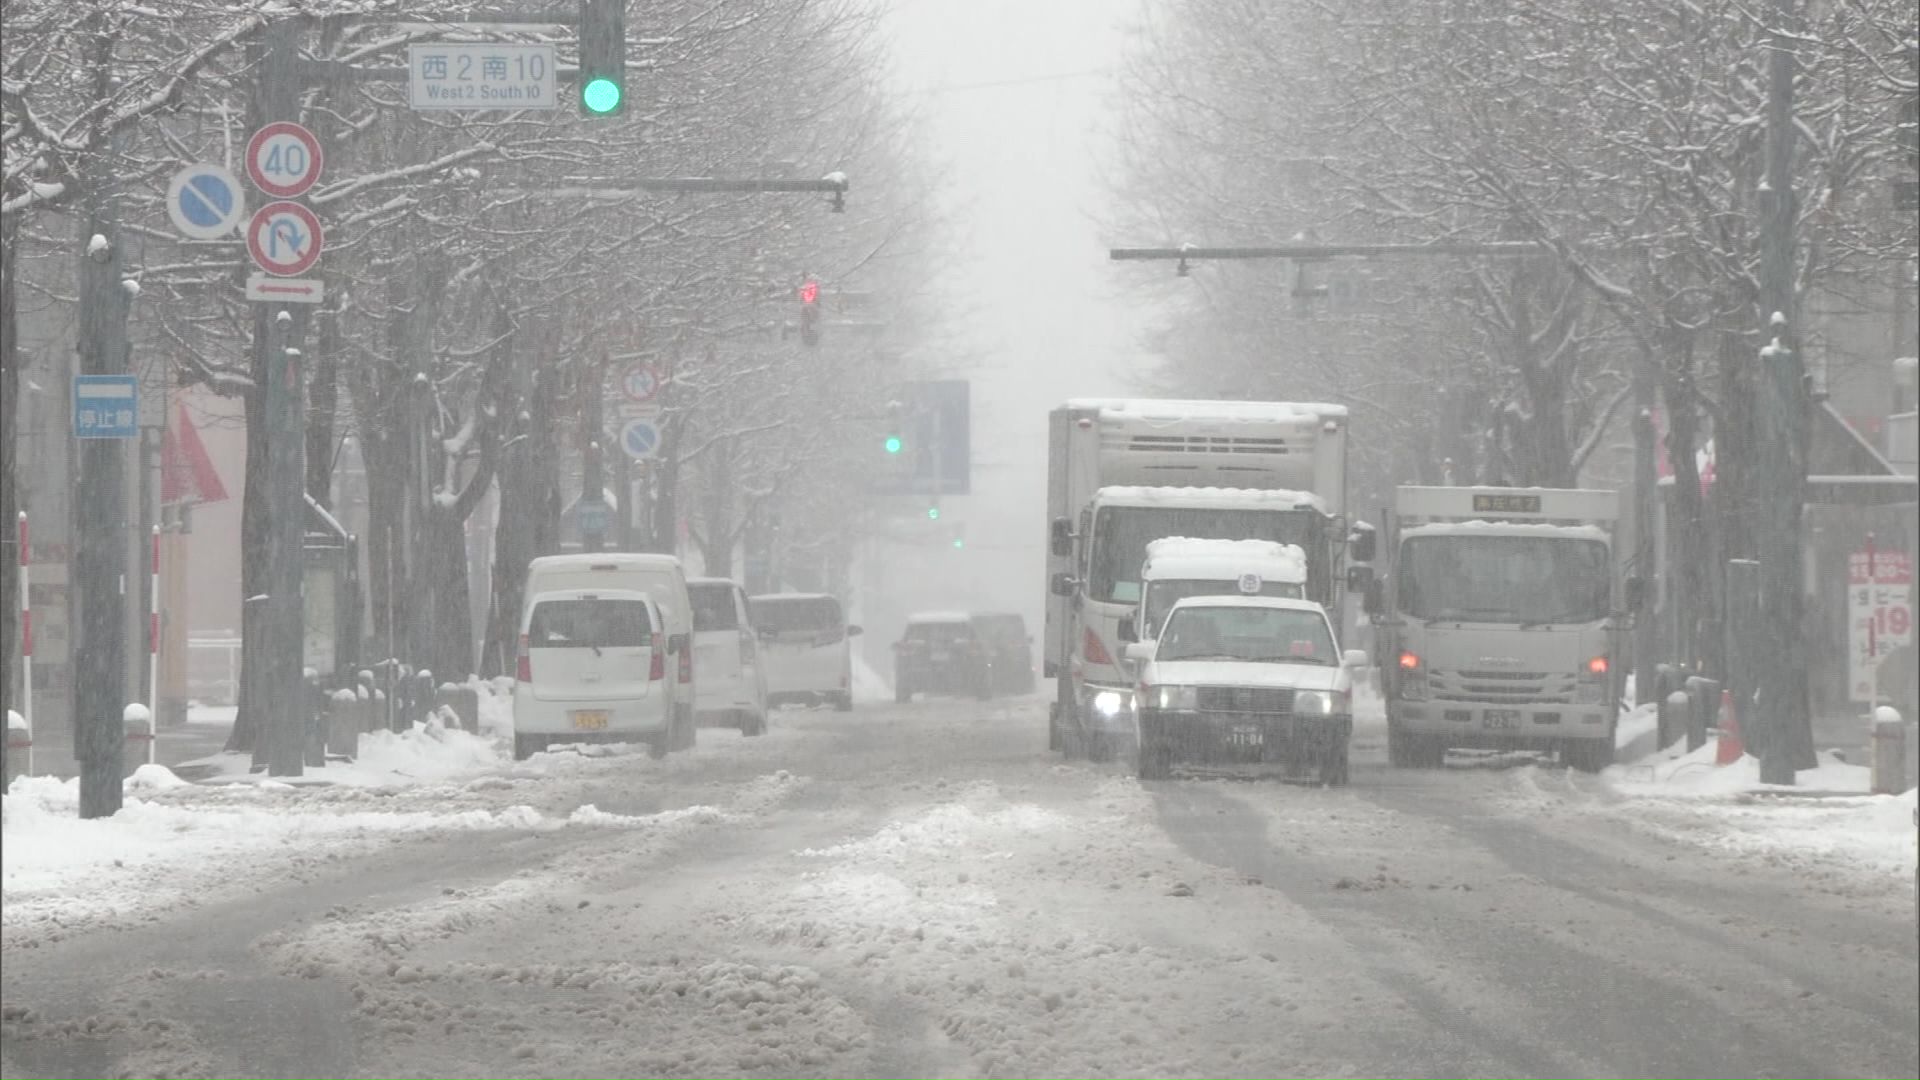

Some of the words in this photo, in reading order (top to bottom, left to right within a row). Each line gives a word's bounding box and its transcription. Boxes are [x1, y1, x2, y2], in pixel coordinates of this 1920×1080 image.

[426, 85, 463, 98] West
[466, 85, 474, 98] 2
[481, 84, 522, 98] South
[527, 85, 541, 98] 10
[264, 144, 305, 176] 40
[79, 409, 133, 428] 停止線
